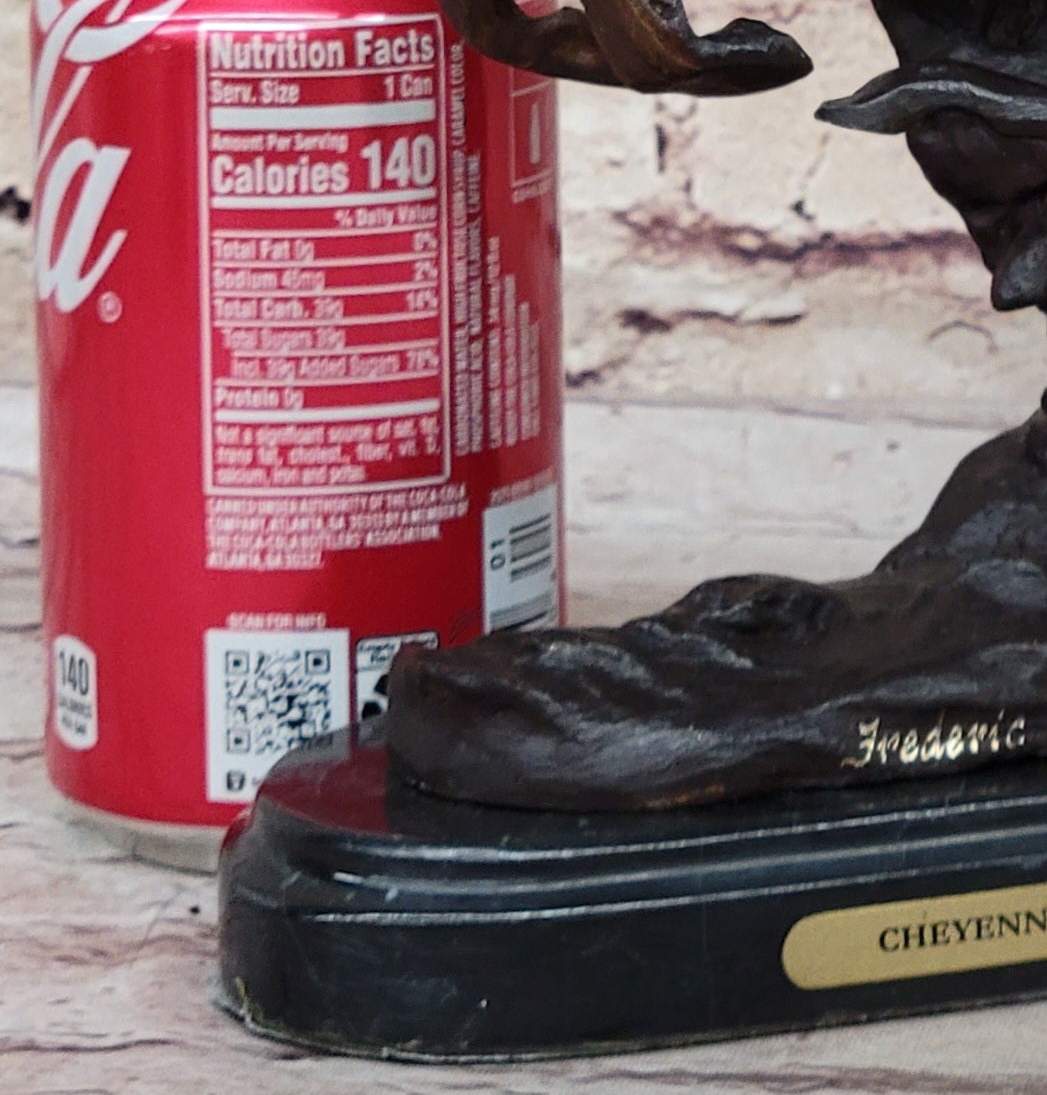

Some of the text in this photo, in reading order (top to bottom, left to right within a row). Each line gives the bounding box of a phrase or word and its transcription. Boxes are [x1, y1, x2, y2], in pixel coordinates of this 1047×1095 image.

[210, 29, 435, 69] Nutrition Facts
[210, 74, 432, 103] Serv. Size 1 Can
[212, 133, 348, 153] Amount Per Serving
[212, 134, 436, 194] Calories 140
[334, 204, 437, 228] % Daily Value
[212, 239, 256, 260] Total
[259, 239, 290, 259] Fat
[213, 270, 277, 289] Sodium
[213, 299, 258, 318] Total
[214, 388, 279, 408] Protein
[226, 612, 327, 628] SCAN FOR INFO
[59, 651, 90, 696] 140
[841, 709, 1027, 767] Frederic
